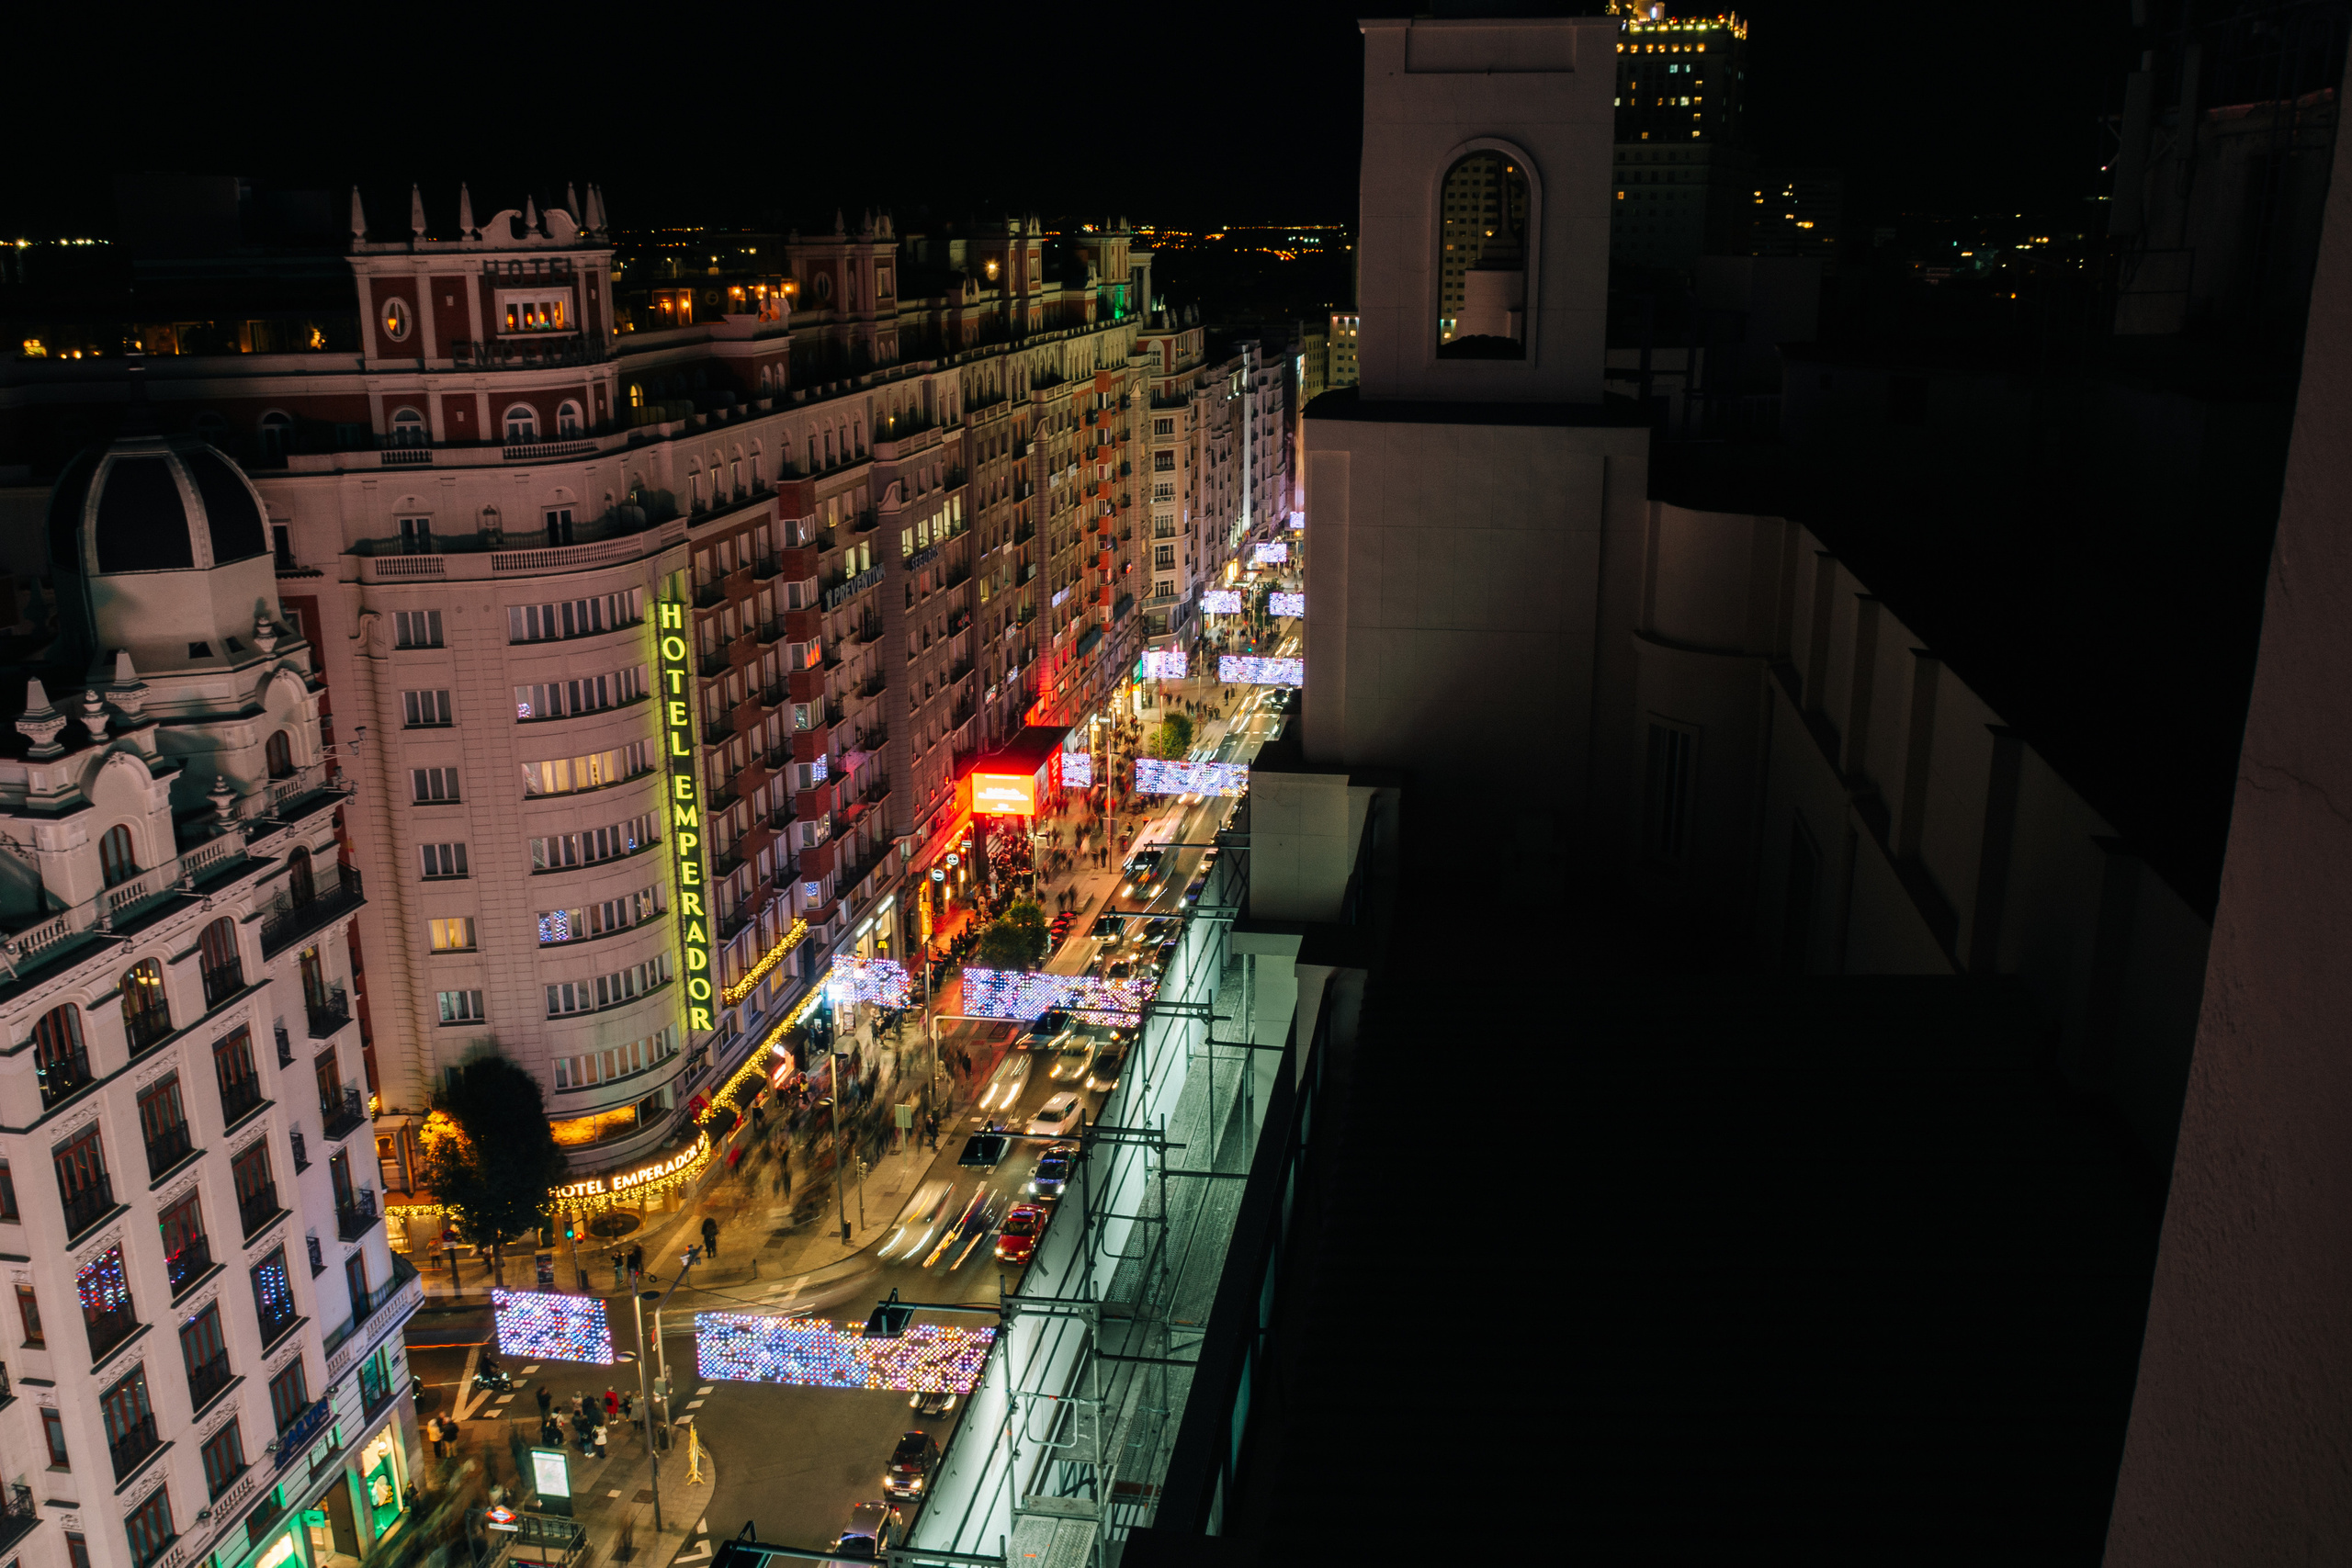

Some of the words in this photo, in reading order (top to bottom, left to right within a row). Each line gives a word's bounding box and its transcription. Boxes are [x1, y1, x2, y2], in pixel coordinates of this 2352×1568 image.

[483, 258, 577, 287] HOTEL
[452, 338, 607, 369] EMPERADOR
[834, 562, 887, 605] PREVENTIVA
[661, 604, 690, 757] HOTEL
[675, 774, 714, 1031] EMPERADOR
[613, 1145, 697, 1190] EMPERADOR
